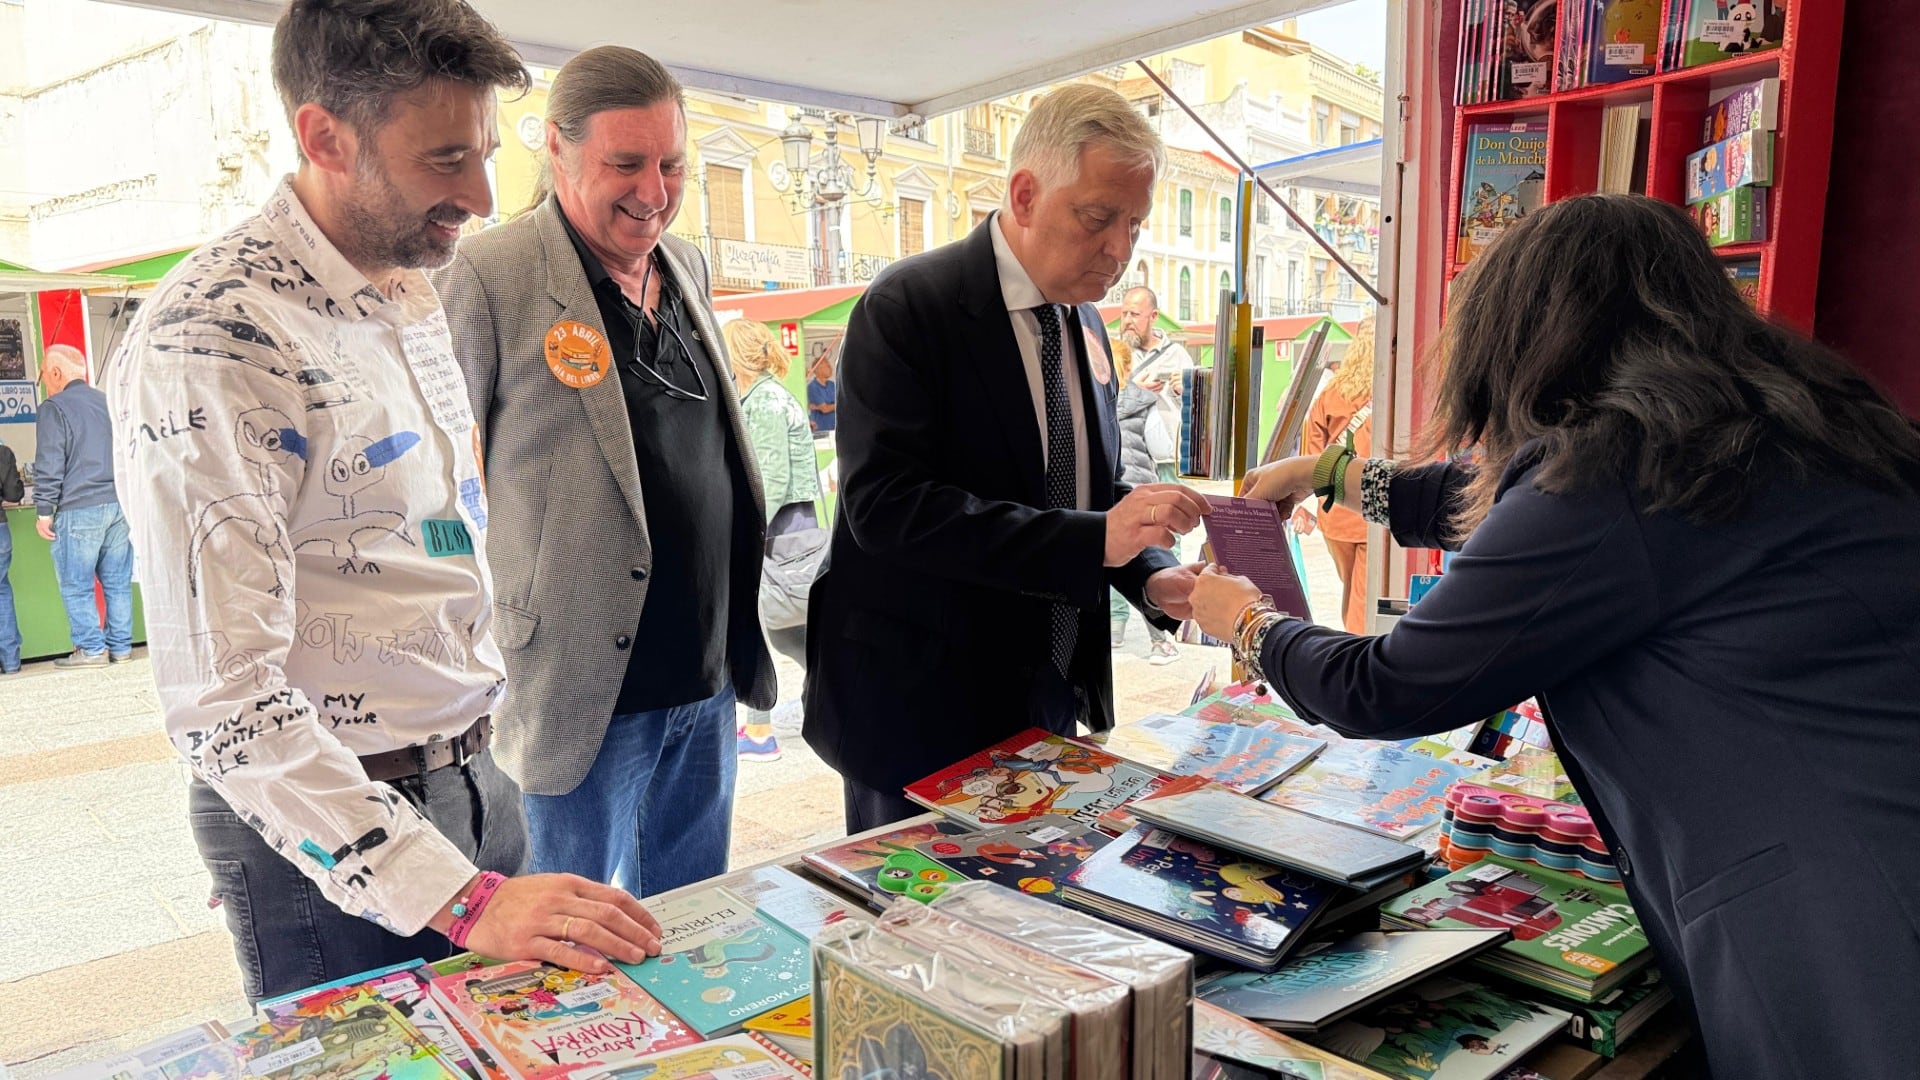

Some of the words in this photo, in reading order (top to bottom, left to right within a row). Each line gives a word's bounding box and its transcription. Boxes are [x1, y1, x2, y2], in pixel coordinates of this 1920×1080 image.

[1479, 138, 1505, 150] Don
[1475, 157, 1485, 165] de
[1487, 156, 1495, 165] la
[291, 219, 316, 250] yeah
[554, 326, 567, 341] 23
[572, 324, 600, 347] ABRIL
[566, 373, 579, 384] DEL
[580, 370, 600, 385] LIBRO
[1419, 576, 1432, 585] 03
[323, 692, 365, 711] MY
[711, 909, 736, 919] EL
[1542, 903, 1635, 952] CAMIONES
[728, 989, 789, 1017] MORENO
[530, 1011, 654, 1054] KADABRA
[576, 1036, 636, 1059] Anna
